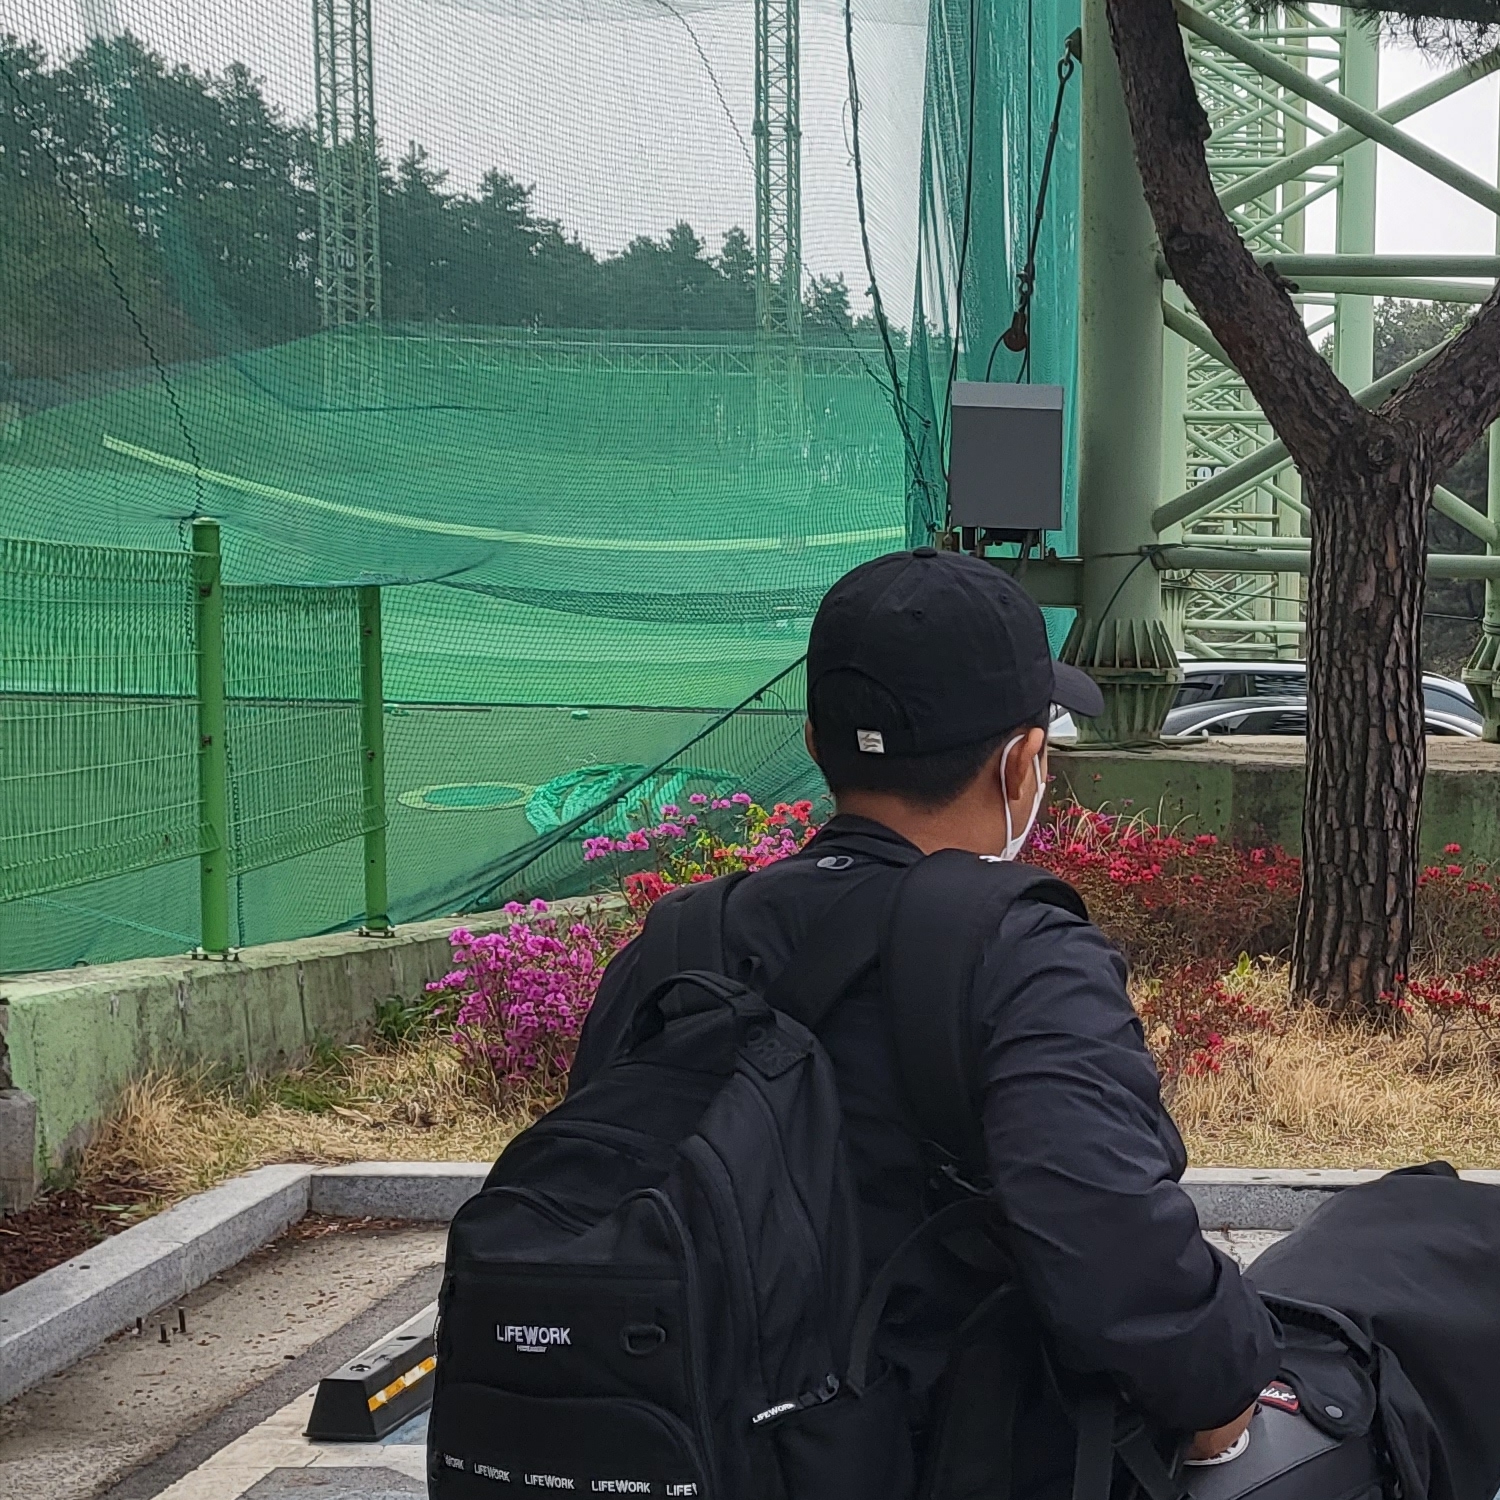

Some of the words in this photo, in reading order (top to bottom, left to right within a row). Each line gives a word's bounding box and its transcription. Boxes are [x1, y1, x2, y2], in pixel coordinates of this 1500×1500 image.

[496, 1324, 572, 1346] LIFEWORK
[474, 1463, 511, 1483] LIFEWORK
[524, 1474, 575, 1491] LIFEWORK
[591, 1479, 651, 1494] LIFEWORK
